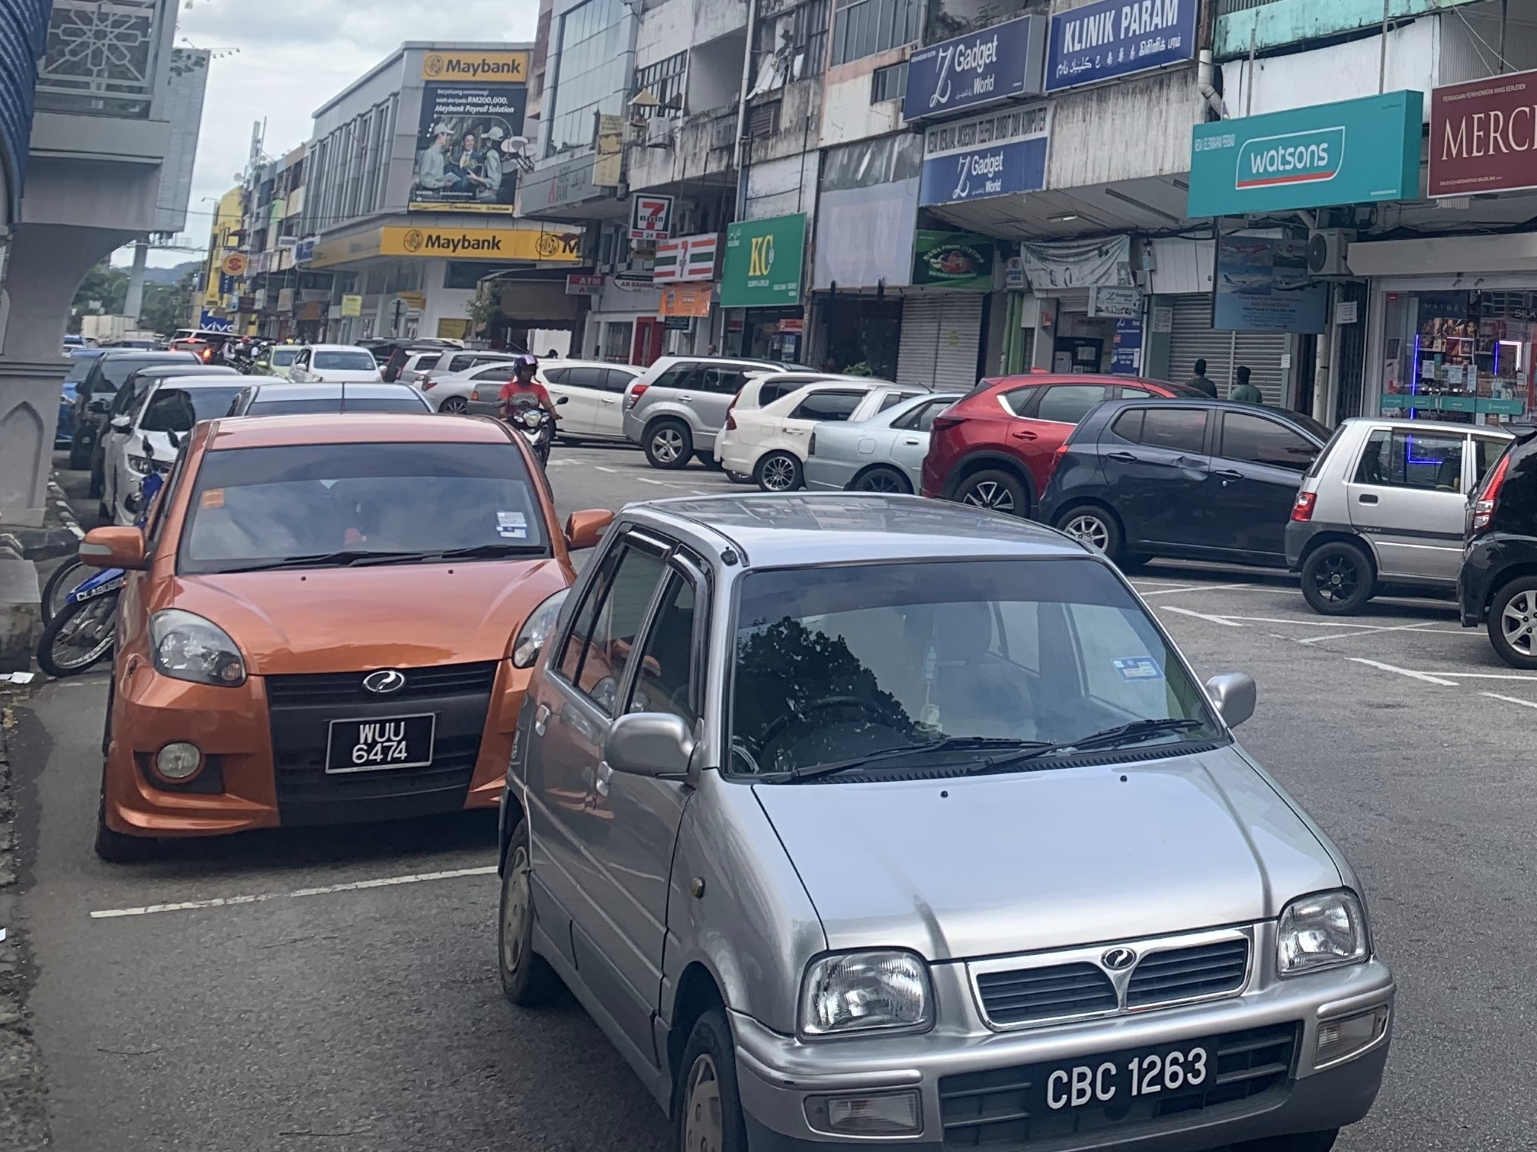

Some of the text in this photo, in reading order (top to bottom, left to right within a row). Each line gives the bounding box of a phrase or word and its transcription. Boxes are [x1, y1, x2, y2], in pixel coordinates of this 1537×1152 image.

[1063, 9, 1116, 54] KLINIK
[954, 34, 998, 73] Gadget
[445, 58, 521, 77] Maybank
[973, 74, 995, 95] World
[434, 104, 515, 114] Maybank Payroll Solution
[971, 150, 1003, 177] Gadget
[1250, 142, 1328, 174] watsons
[985, 179, 1002, 193] World
[425, 234, 502, 253] Maybank
[748, 234, 774, 276] KC
[358, 722, 405, 744] WUU
[352, 741, 408, 764] 6474
[1046, 1047, 1209, 1111] CBC 1263
